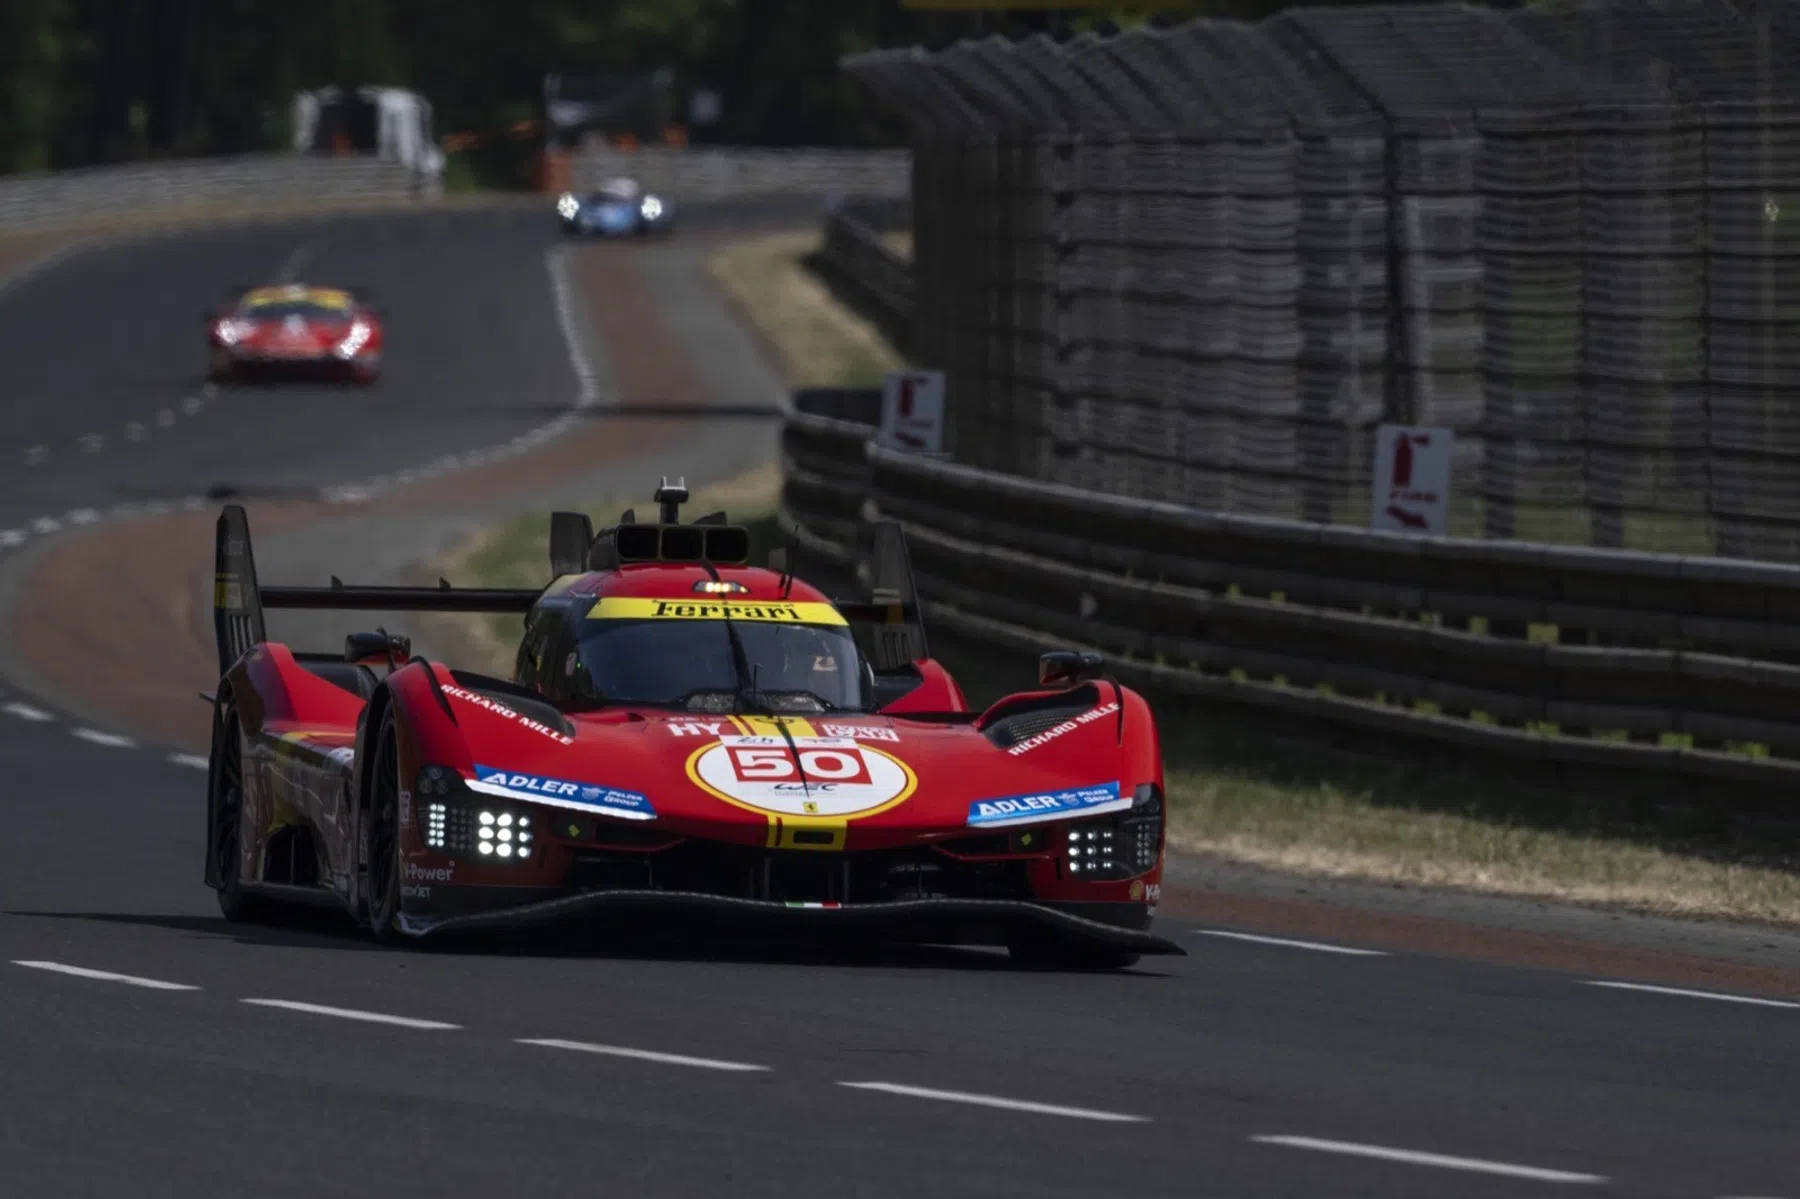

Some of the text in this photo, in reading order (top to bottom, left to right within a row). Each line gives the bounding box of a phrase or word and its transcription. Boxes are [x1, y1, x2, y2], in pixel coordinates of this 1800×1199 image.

[651, 599, 802, 620] Ferrari
[440, 684, 574, 745] RICHARD MILLE
[667, 723, 721, 737] HY
[1008, 702, 1120, 756] RICHARD MILLE
[735, 750, 861, 779] 50
[481, 772, 579, 796] ADLER
[977, 795, 1062, 816] ADLER
